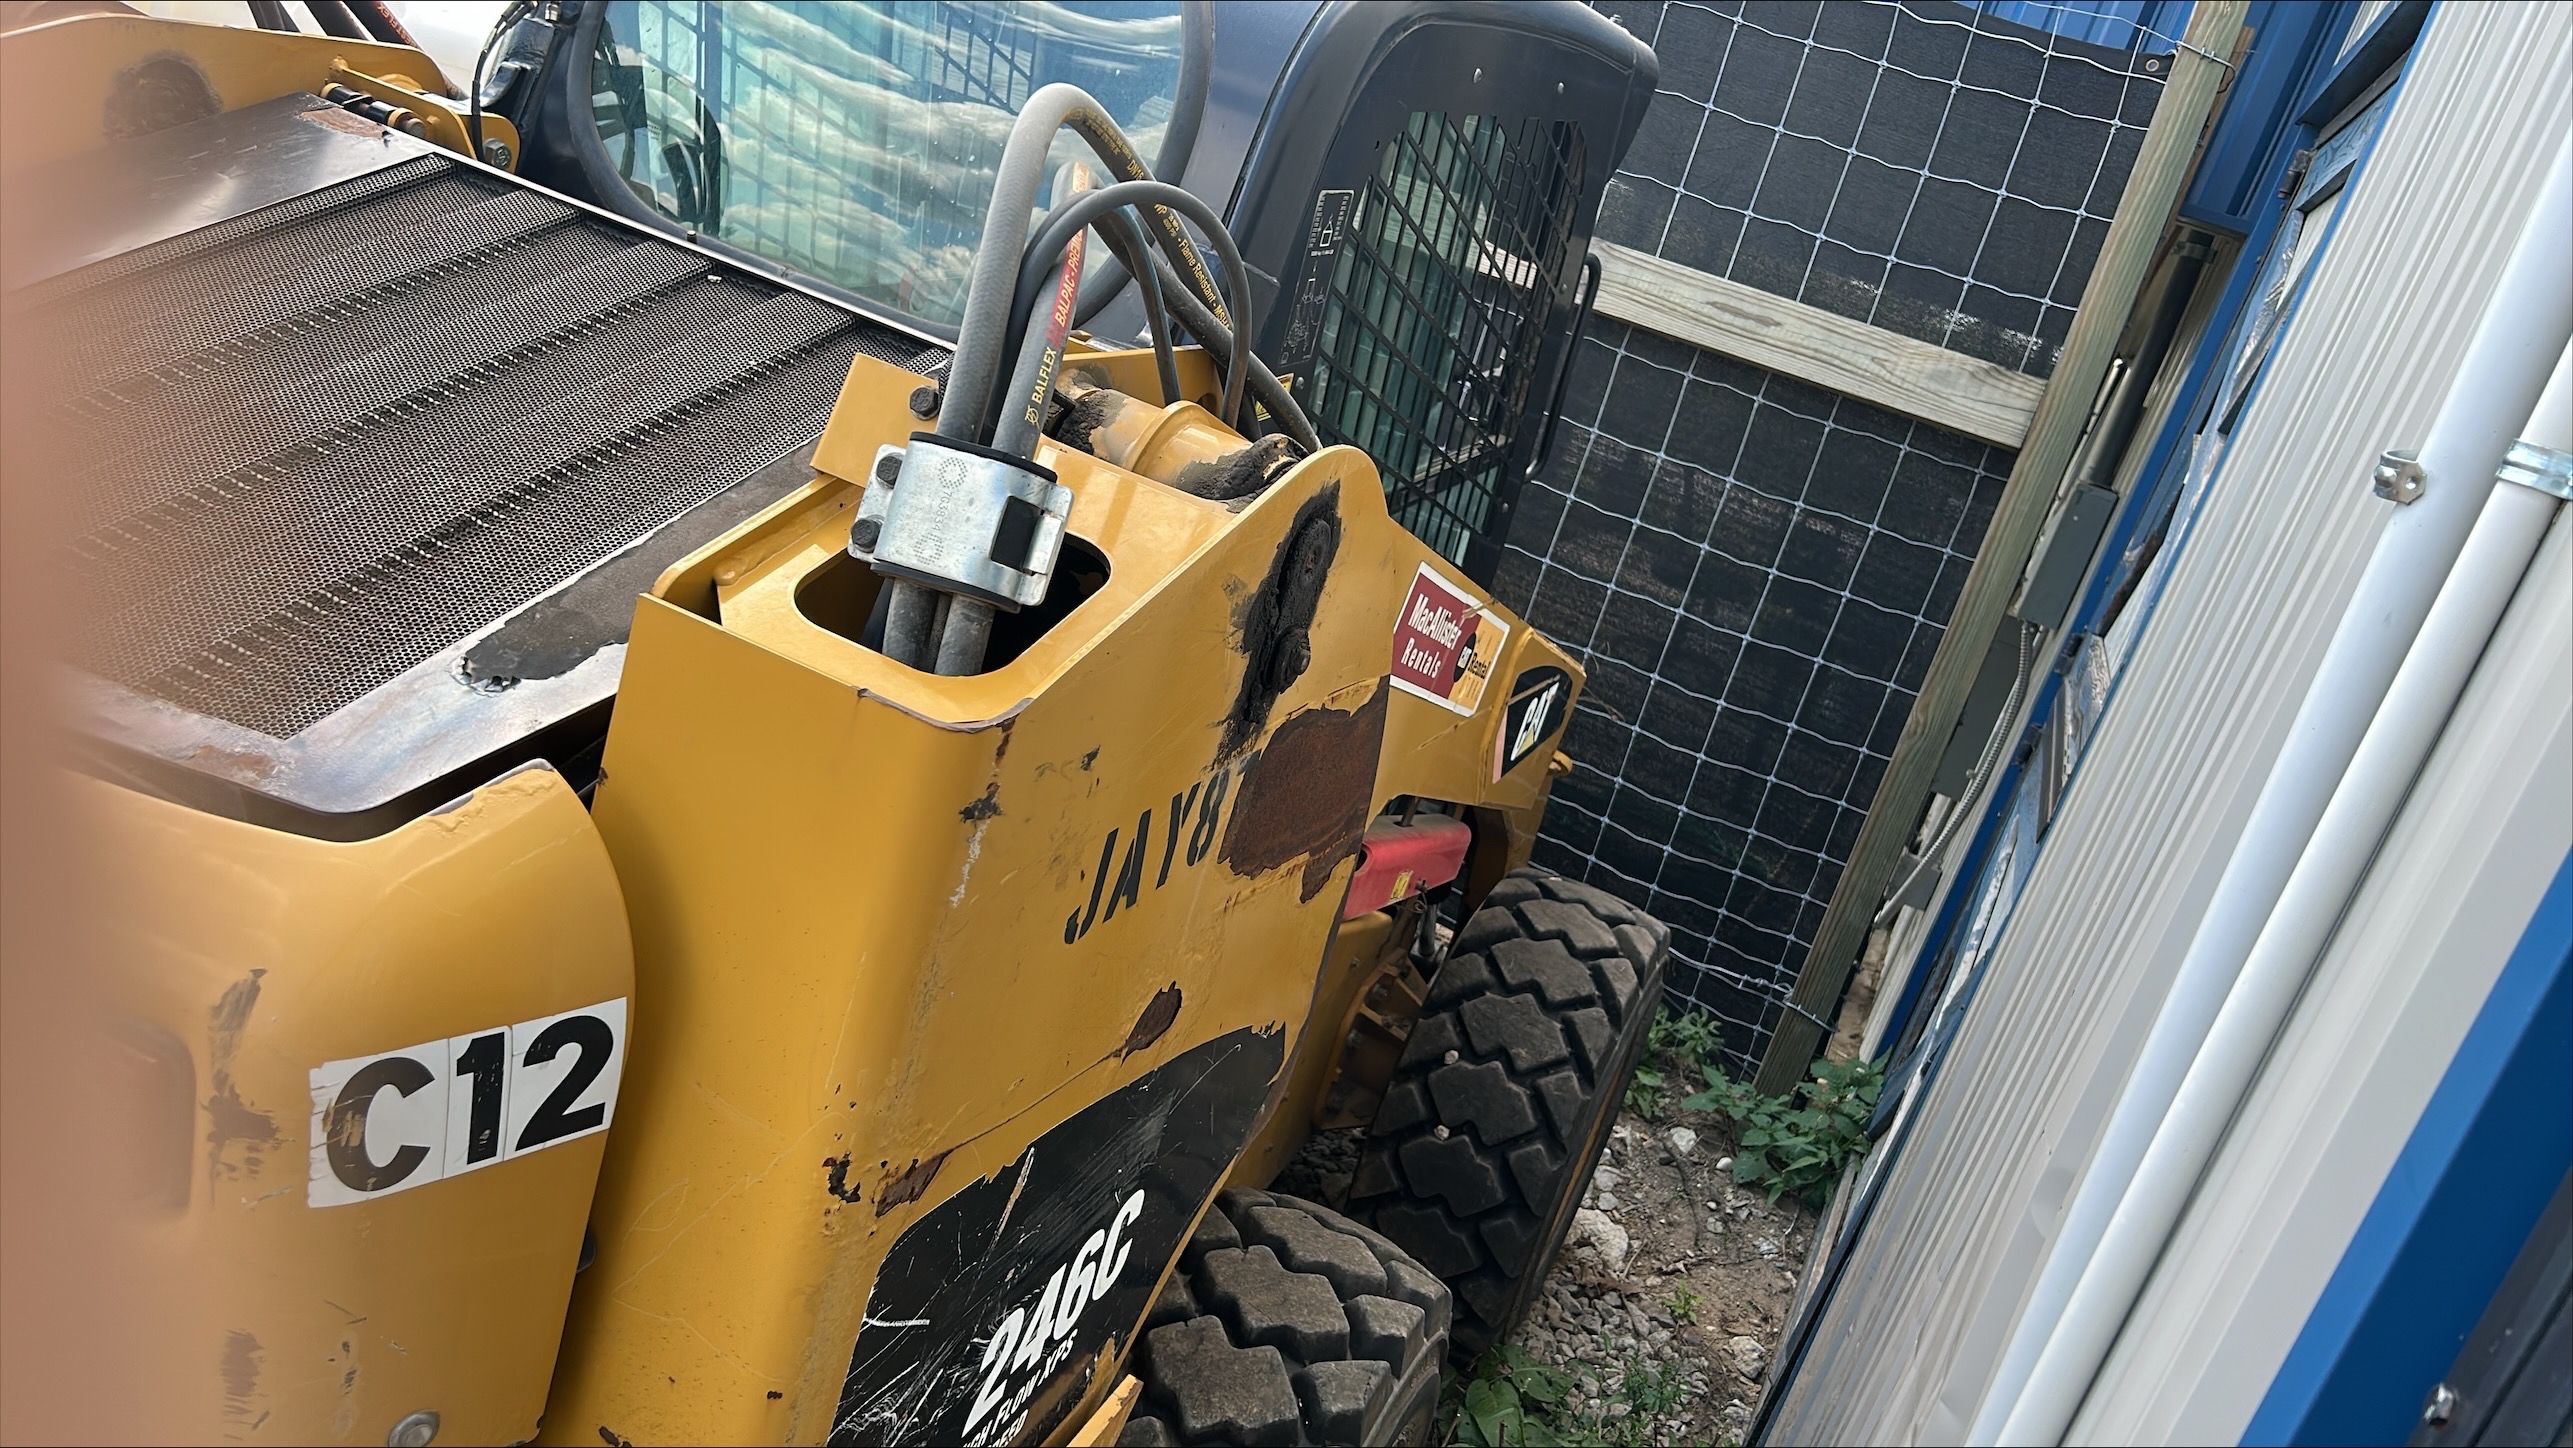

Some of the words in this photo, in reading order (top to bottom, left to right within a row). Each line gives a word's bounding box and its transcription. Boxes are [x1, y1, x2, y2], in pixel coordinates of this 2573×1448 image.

[1178, 238, 1195, 266] Flame
[1192, 262, 1217, 303] Resistant
[1031, 347, 1057, 405] BALFLEX
[1055, 274, 1075, 327] BALPAC
[1401, 637, 1442, 679] Rentals
[1408, 593, 1462, 650] MacAllister
[1510, 682, 1559, 761] CAT
[1064, 750, 1262, 945] JAY8
[326, 1015, 614, 1192] C12
[962, 1188, 1145, 1438] 246C
[991, 1369, 1041, 1435] FLOW
[1037, 1328, 1078, 1387] XPS
